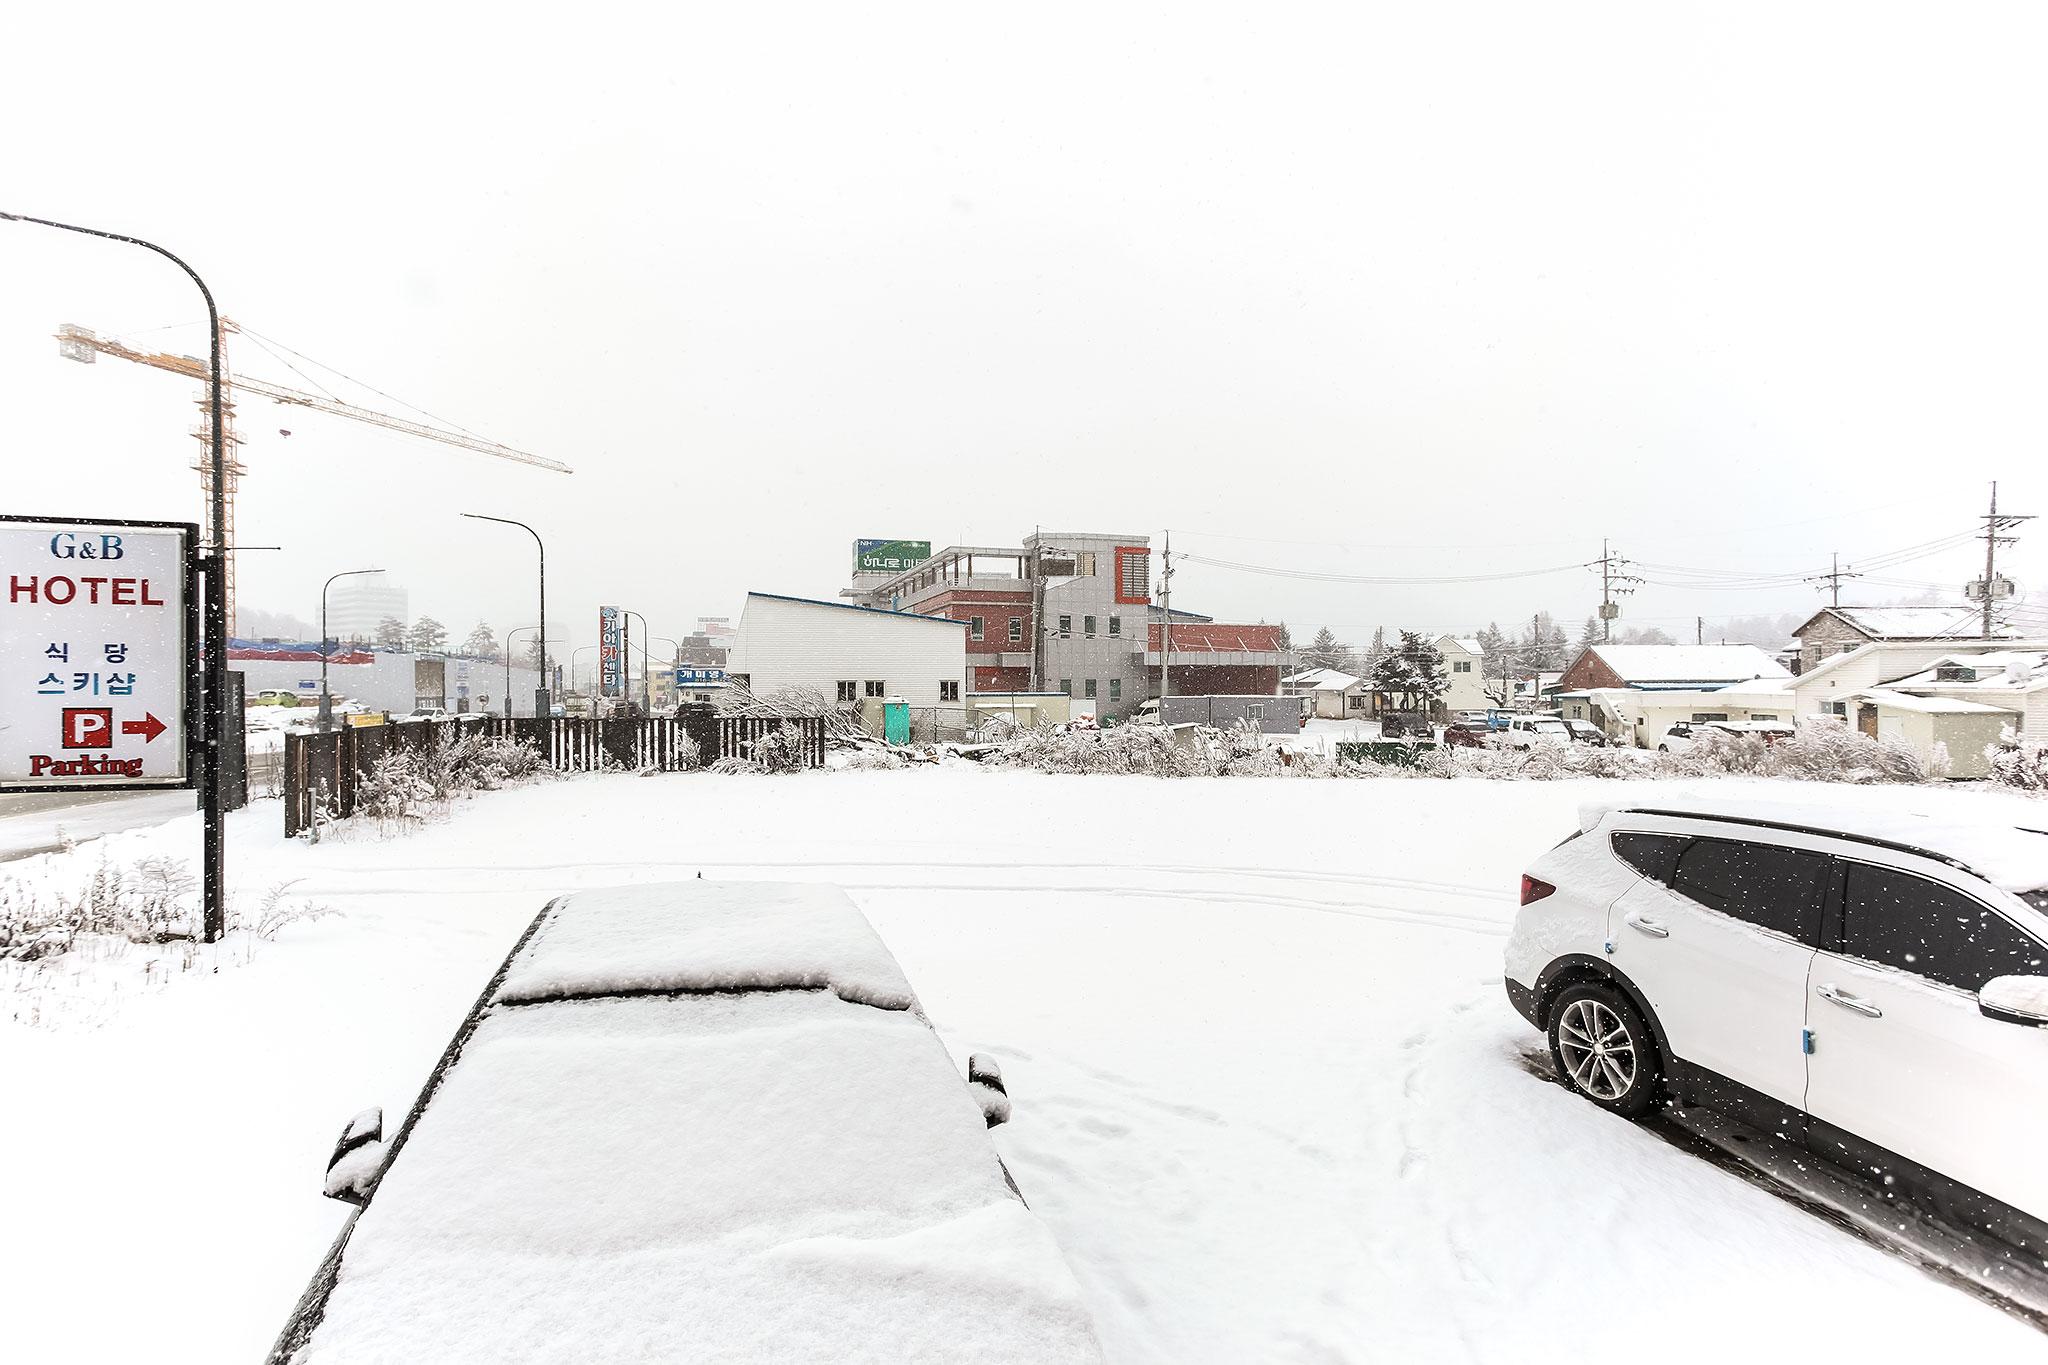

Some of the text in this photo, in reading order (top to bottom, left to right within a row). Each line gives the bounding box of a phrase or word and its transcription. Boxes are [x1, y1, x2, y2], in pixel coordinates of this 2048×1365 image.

[50, 532, 124, 560] G&B
[863, 555, 900, 568] 하나로
[9, 575, 164, 606] HOTEL
[601, 621, 617, 687] 기아카센타
[37, 671, 136, 696] 스키샵
[74, 714, 105, 743] P
[29, 753, 144, 778] Parking
